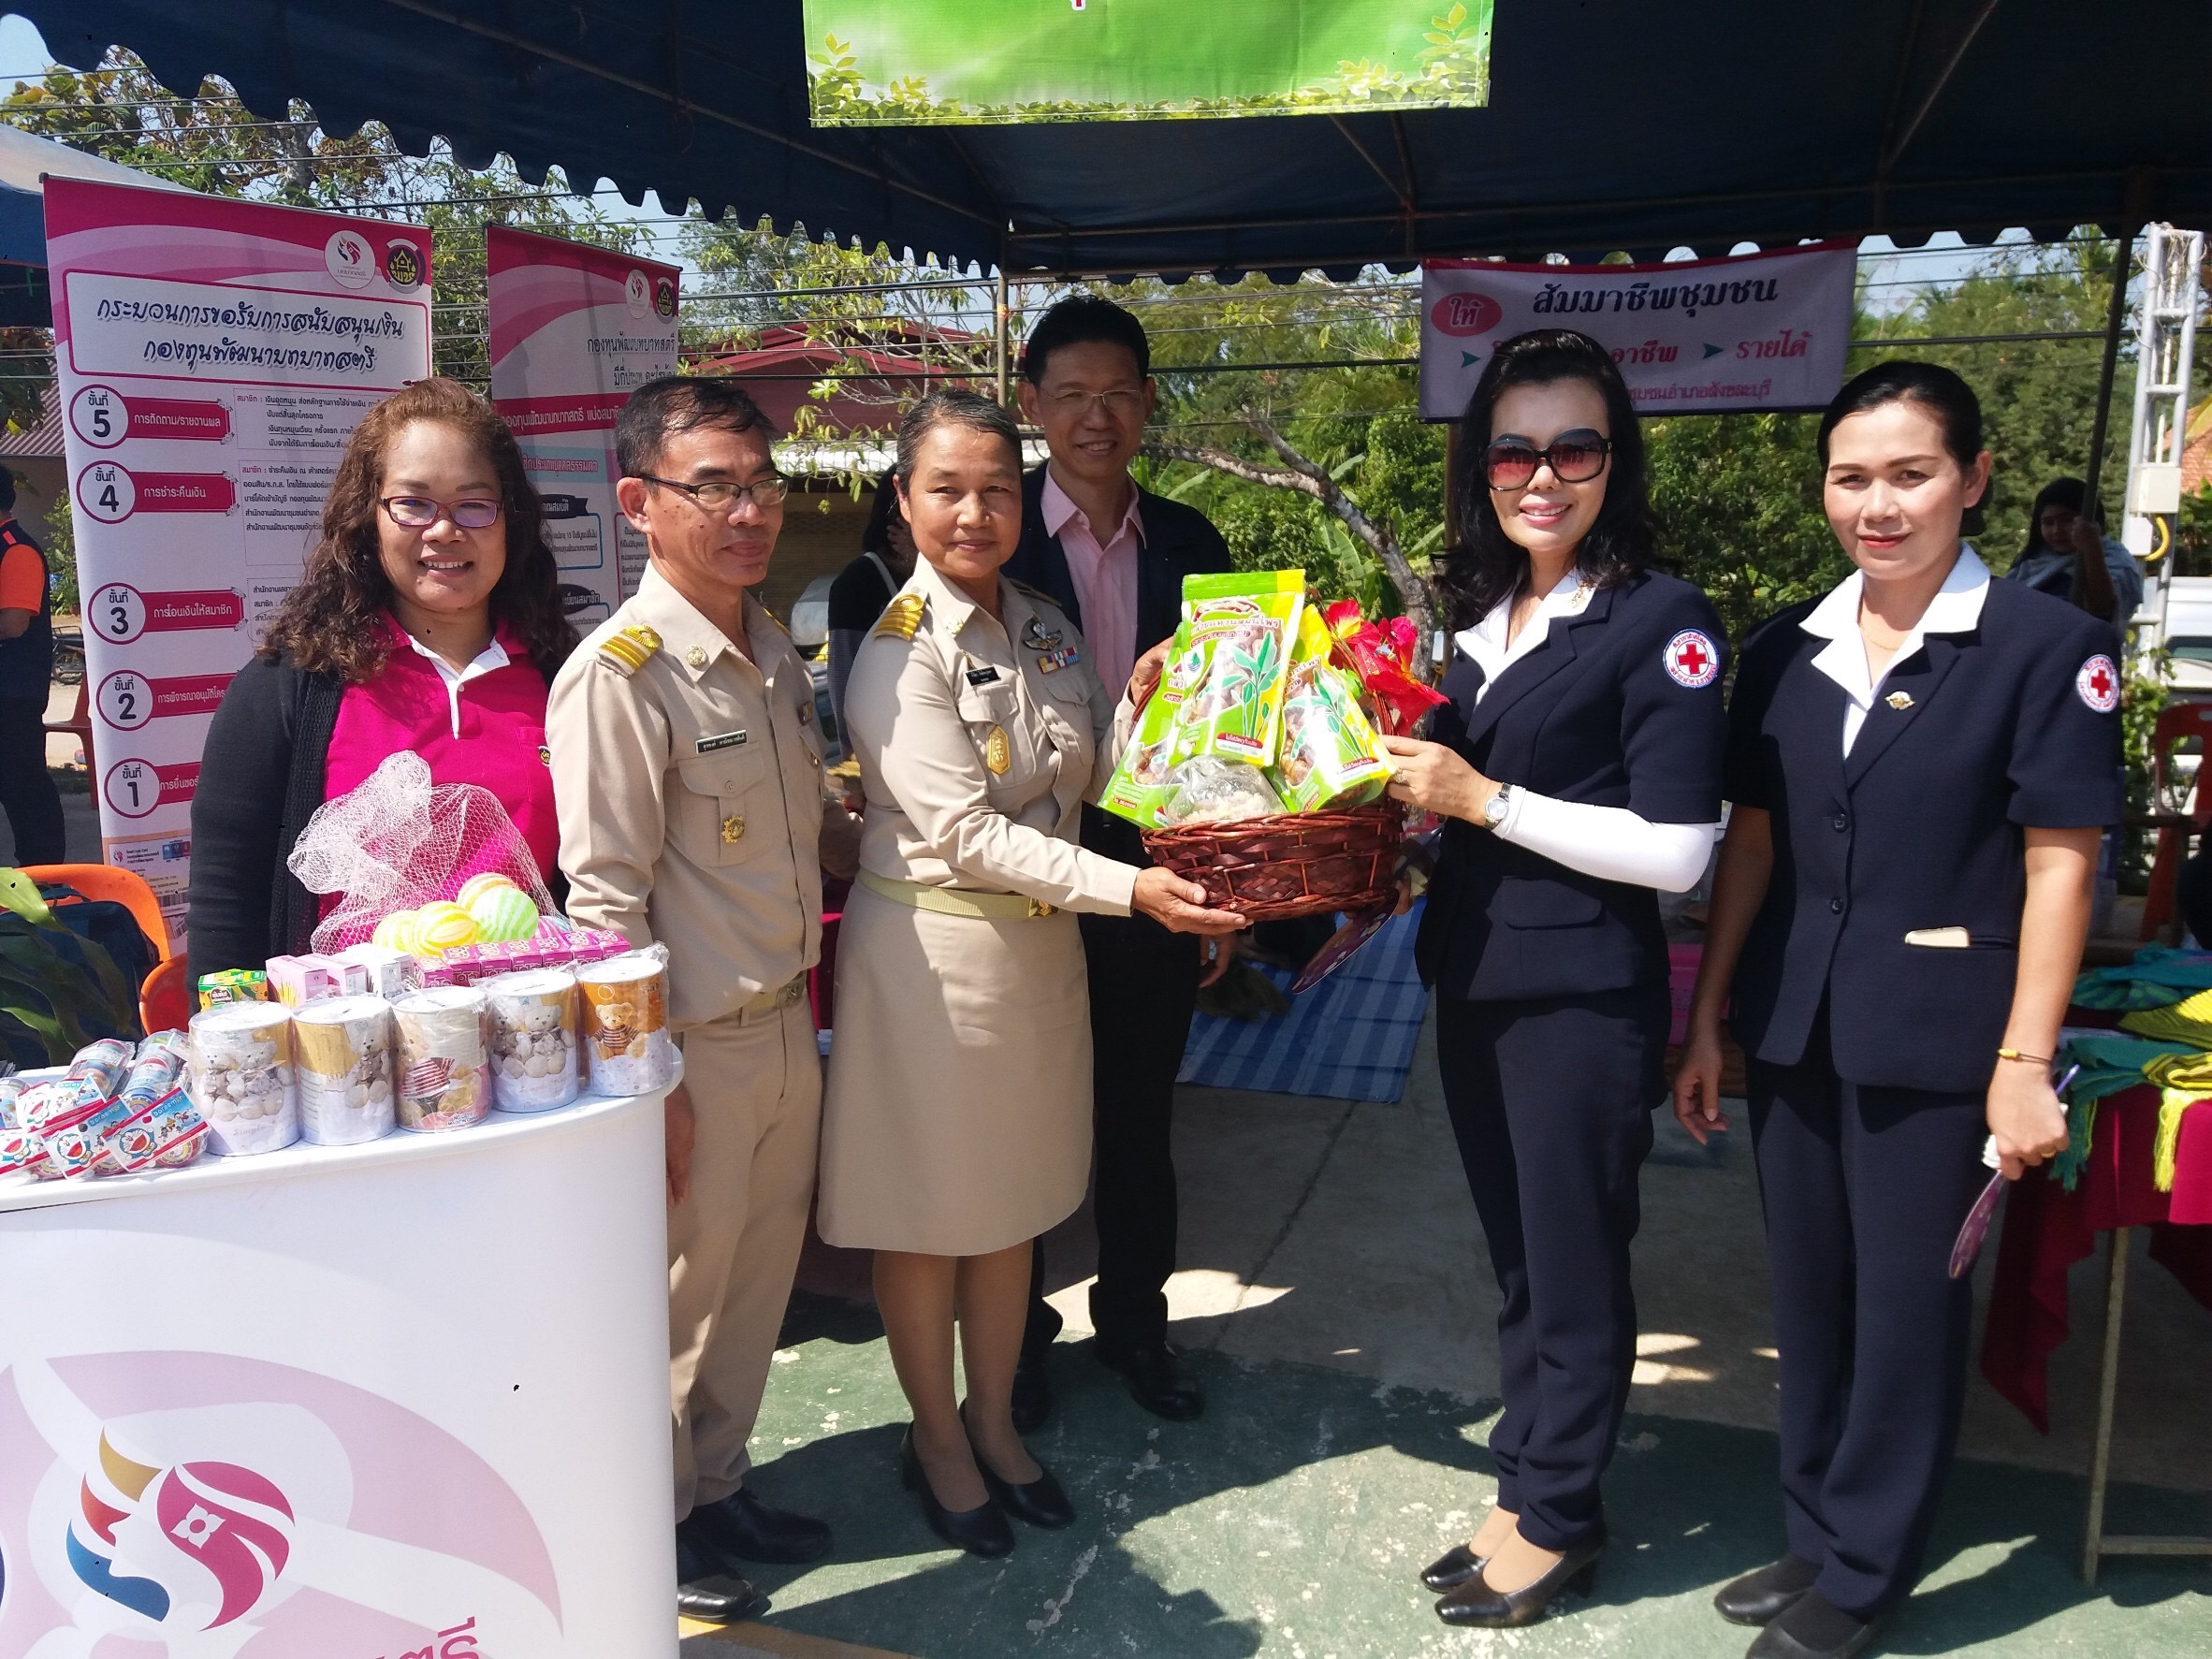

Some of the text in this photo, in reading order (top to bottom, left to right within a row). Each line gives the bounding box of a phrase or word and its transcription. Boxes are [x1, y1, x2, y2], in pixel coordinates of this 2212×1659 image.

[1532, 277, 1779, 317] สัมมาชีพชุมชน
[97, 297, 404, 341] กระบวนการขอรับการสนับสนุนเงิน
[1448, 297, 1480, 327] ให้
[143, 335, 377, 372] กองทุนพัฒนาบทบาทสตรี
[1611, 339, 1679, 365] อาชีพ
[1736, 329, 1812, 360] รายได้
[88, 389, 109, 407] ขั้นที่
[1628, 378, 1772, 402] ชุมชนอำเภอสังขละบุรี
[92, 409, 111, 438] 5
[134, 412, 222, 429] การติดตาม/รายงานผล
[95, 467, 116, 483] ขั้นที่
[98, 485, 120, 513] 4
[143, 486, 207, 501] การชำระคืนเงิน
[109, 589, 129, 604] ขั้นที่
[109, 607, 129, 634] 3
[153, 603, 233, 618] การโอนเงินให้สมาชิก
[114, 675, 135, 691] ขั้นที่
[118, 692, 138, 720] 2
[157, 688, 226, 705] การพิจารณาอนุมัติโคร
[122, 764, 142, 779] ขั้นที่
[159, 775, 199, 791] การยื่นขอรั
[126, 781, 139, 808] 1
